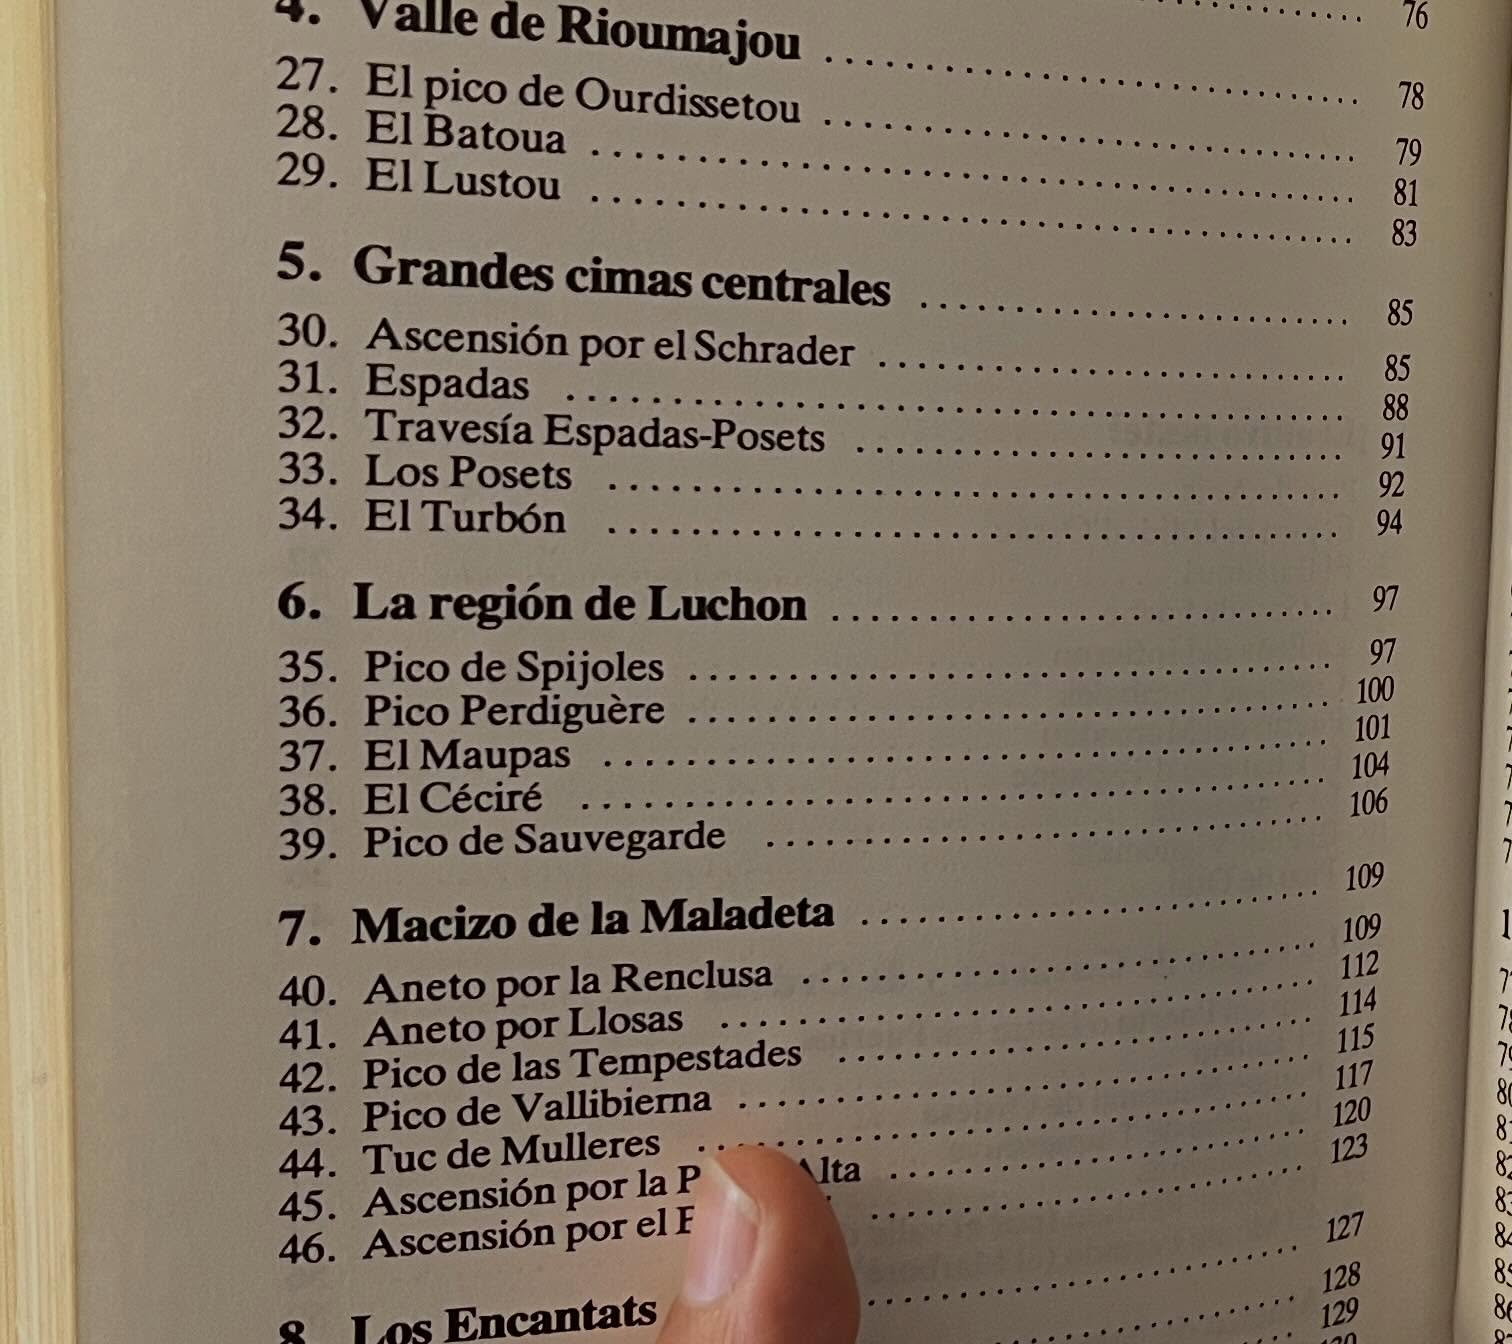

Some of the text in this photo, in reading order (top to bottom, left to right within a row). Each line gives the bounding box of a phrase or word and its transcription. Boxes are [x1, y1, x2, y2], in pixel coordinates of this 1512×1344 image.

[490, 0, 546, 42] de
[556, 3, 802, 67] Rioumajou
[1398, 80, 1425, 111] 78
[275, 55, 1422, 167] 27. El pico de Ourdissetou 79
[276, 240, 1414, 327] 5. Grandes cimas centrales 85
[278, 404, 1406, 460] 32. Travesía Espadas-Posets 91
[277, 580, 1400, 631] 6. La región de Luchon 97
[279, 749, 1390, 817] 38. El Céciré 104
[277, 861, 1385, 947] 7. Macizo de la Maladeta 109
[278, 1022, 1376, 1137] 43. Pico de Vallibierna 115
[278, 1058, 1374, 1180] 44. Tuc de Mulleres 117
[442, 1295, 658, 1344] Encantats
[1326, 1210, 1365, 1244] 127
[1322, 1260, 1361, 1295] 128
